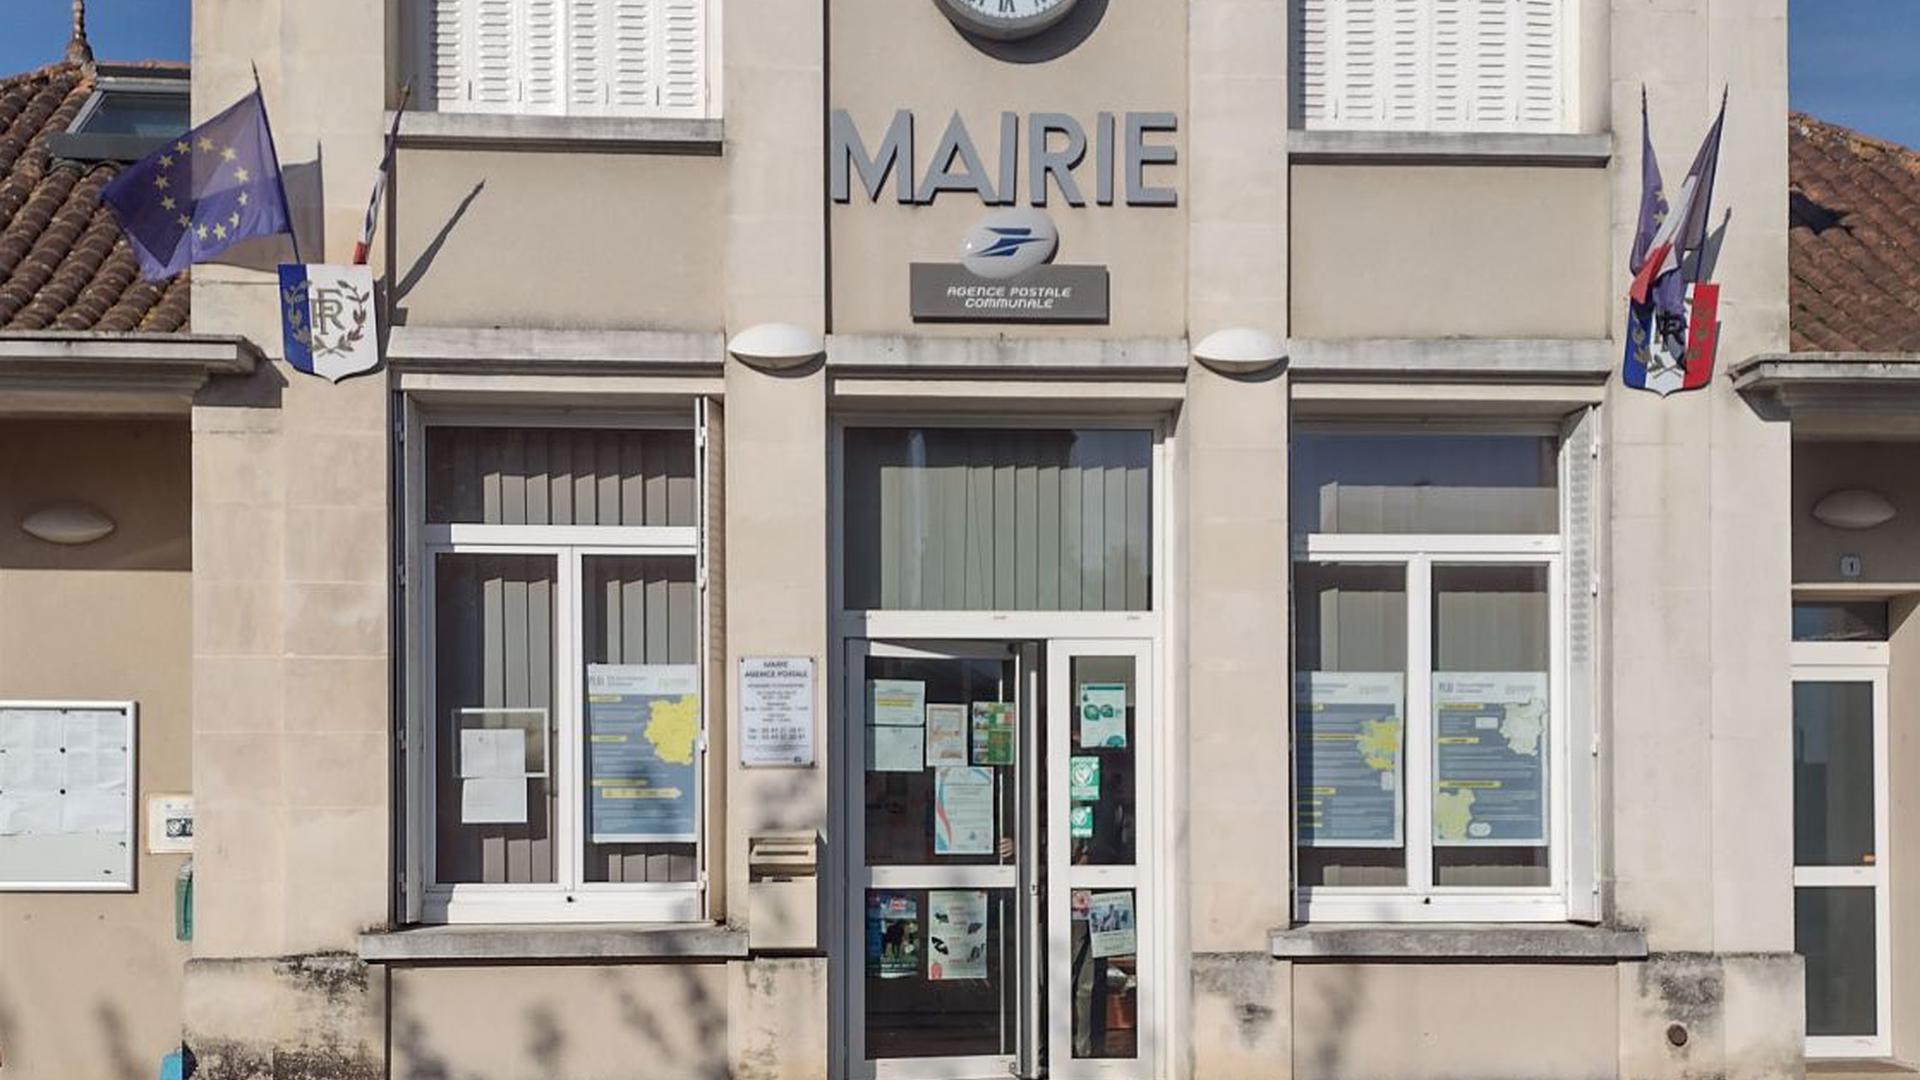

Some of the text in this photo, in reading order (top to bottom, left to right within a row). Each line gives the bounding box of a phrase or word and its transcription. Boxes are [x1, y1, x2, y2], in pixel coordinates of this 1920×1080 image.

[831, 109, 1177, 207] MAIRIE
[946, 286, 1072, 298] AGENCE POSTALE
[964, 298, 1054, 309] COMMUNALE
